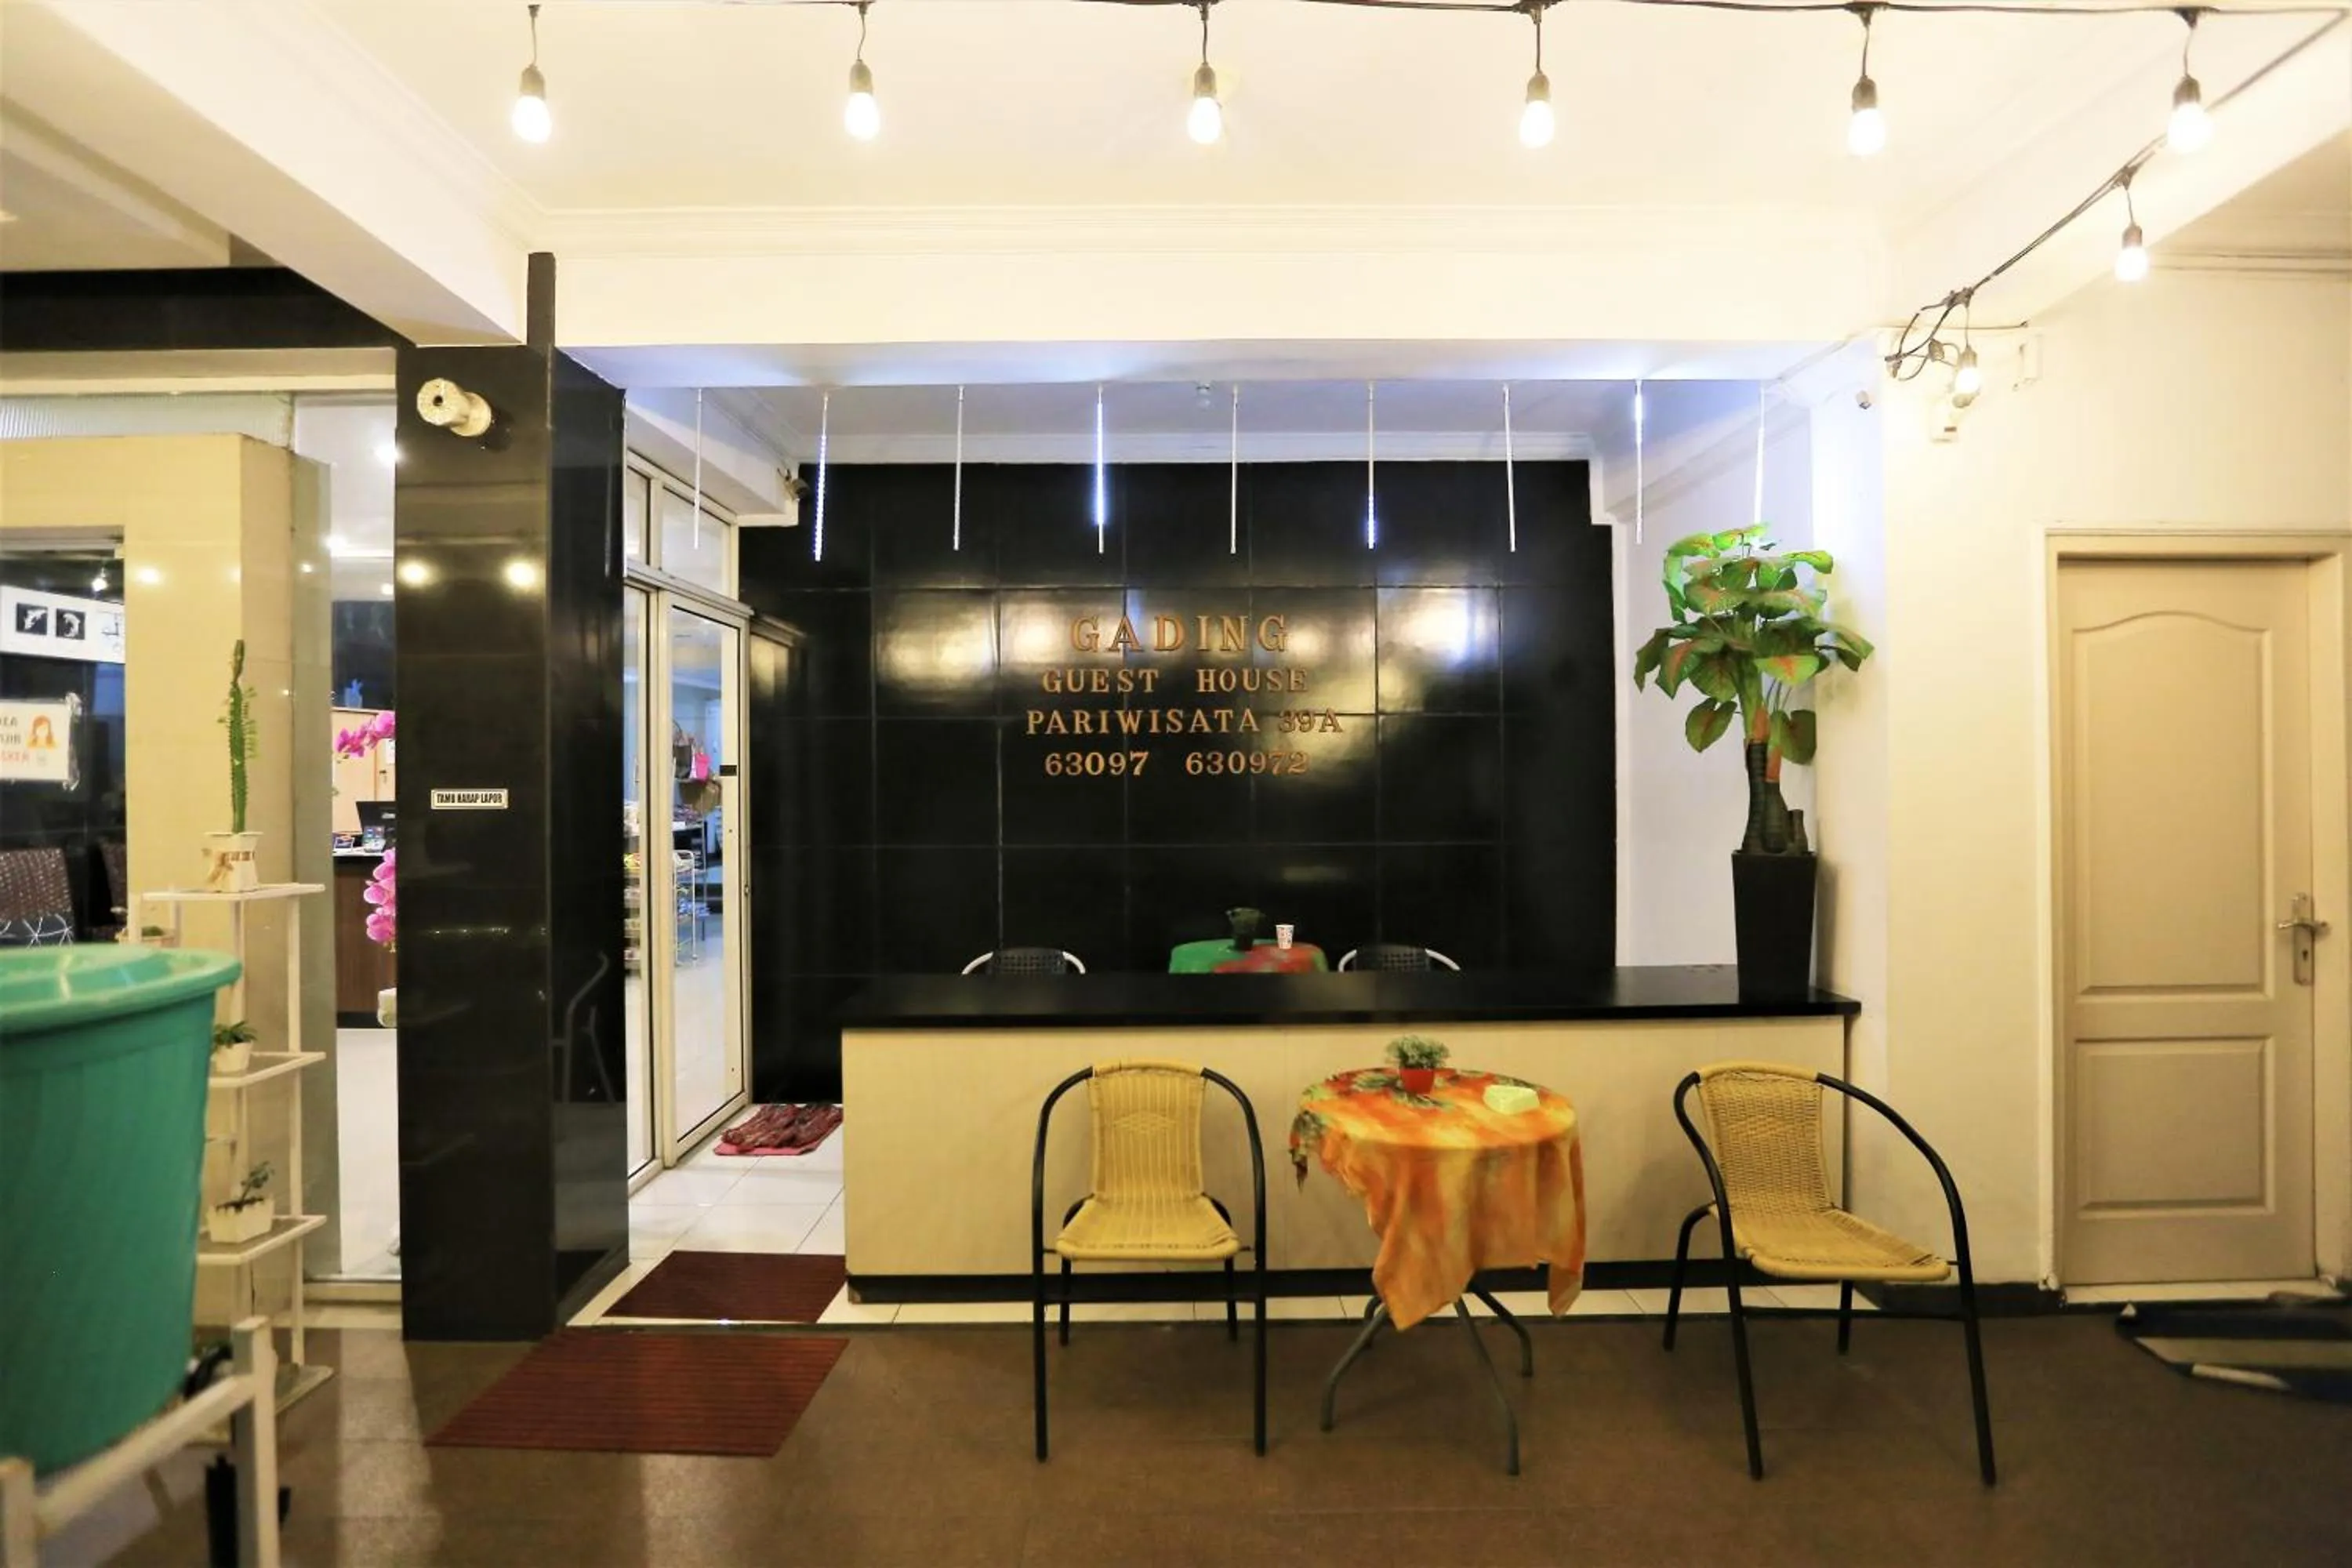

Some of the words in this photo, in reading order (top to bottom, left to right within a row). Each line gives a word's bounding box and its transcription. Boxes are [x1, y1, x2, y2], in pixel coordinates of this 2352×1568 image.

[1069, 614, 1289, 652] GADING
[1042, 668, 1159, 694] GUEST
[1196, 668, 1309, 693] HOUSE
[1025, 708, 1261, 735] PARIWISATA
[1279, 708, 1344, 734] 39A
[1044, 751, 1149, 776] 63097
[1185, 750, 1310, 775] 630972
